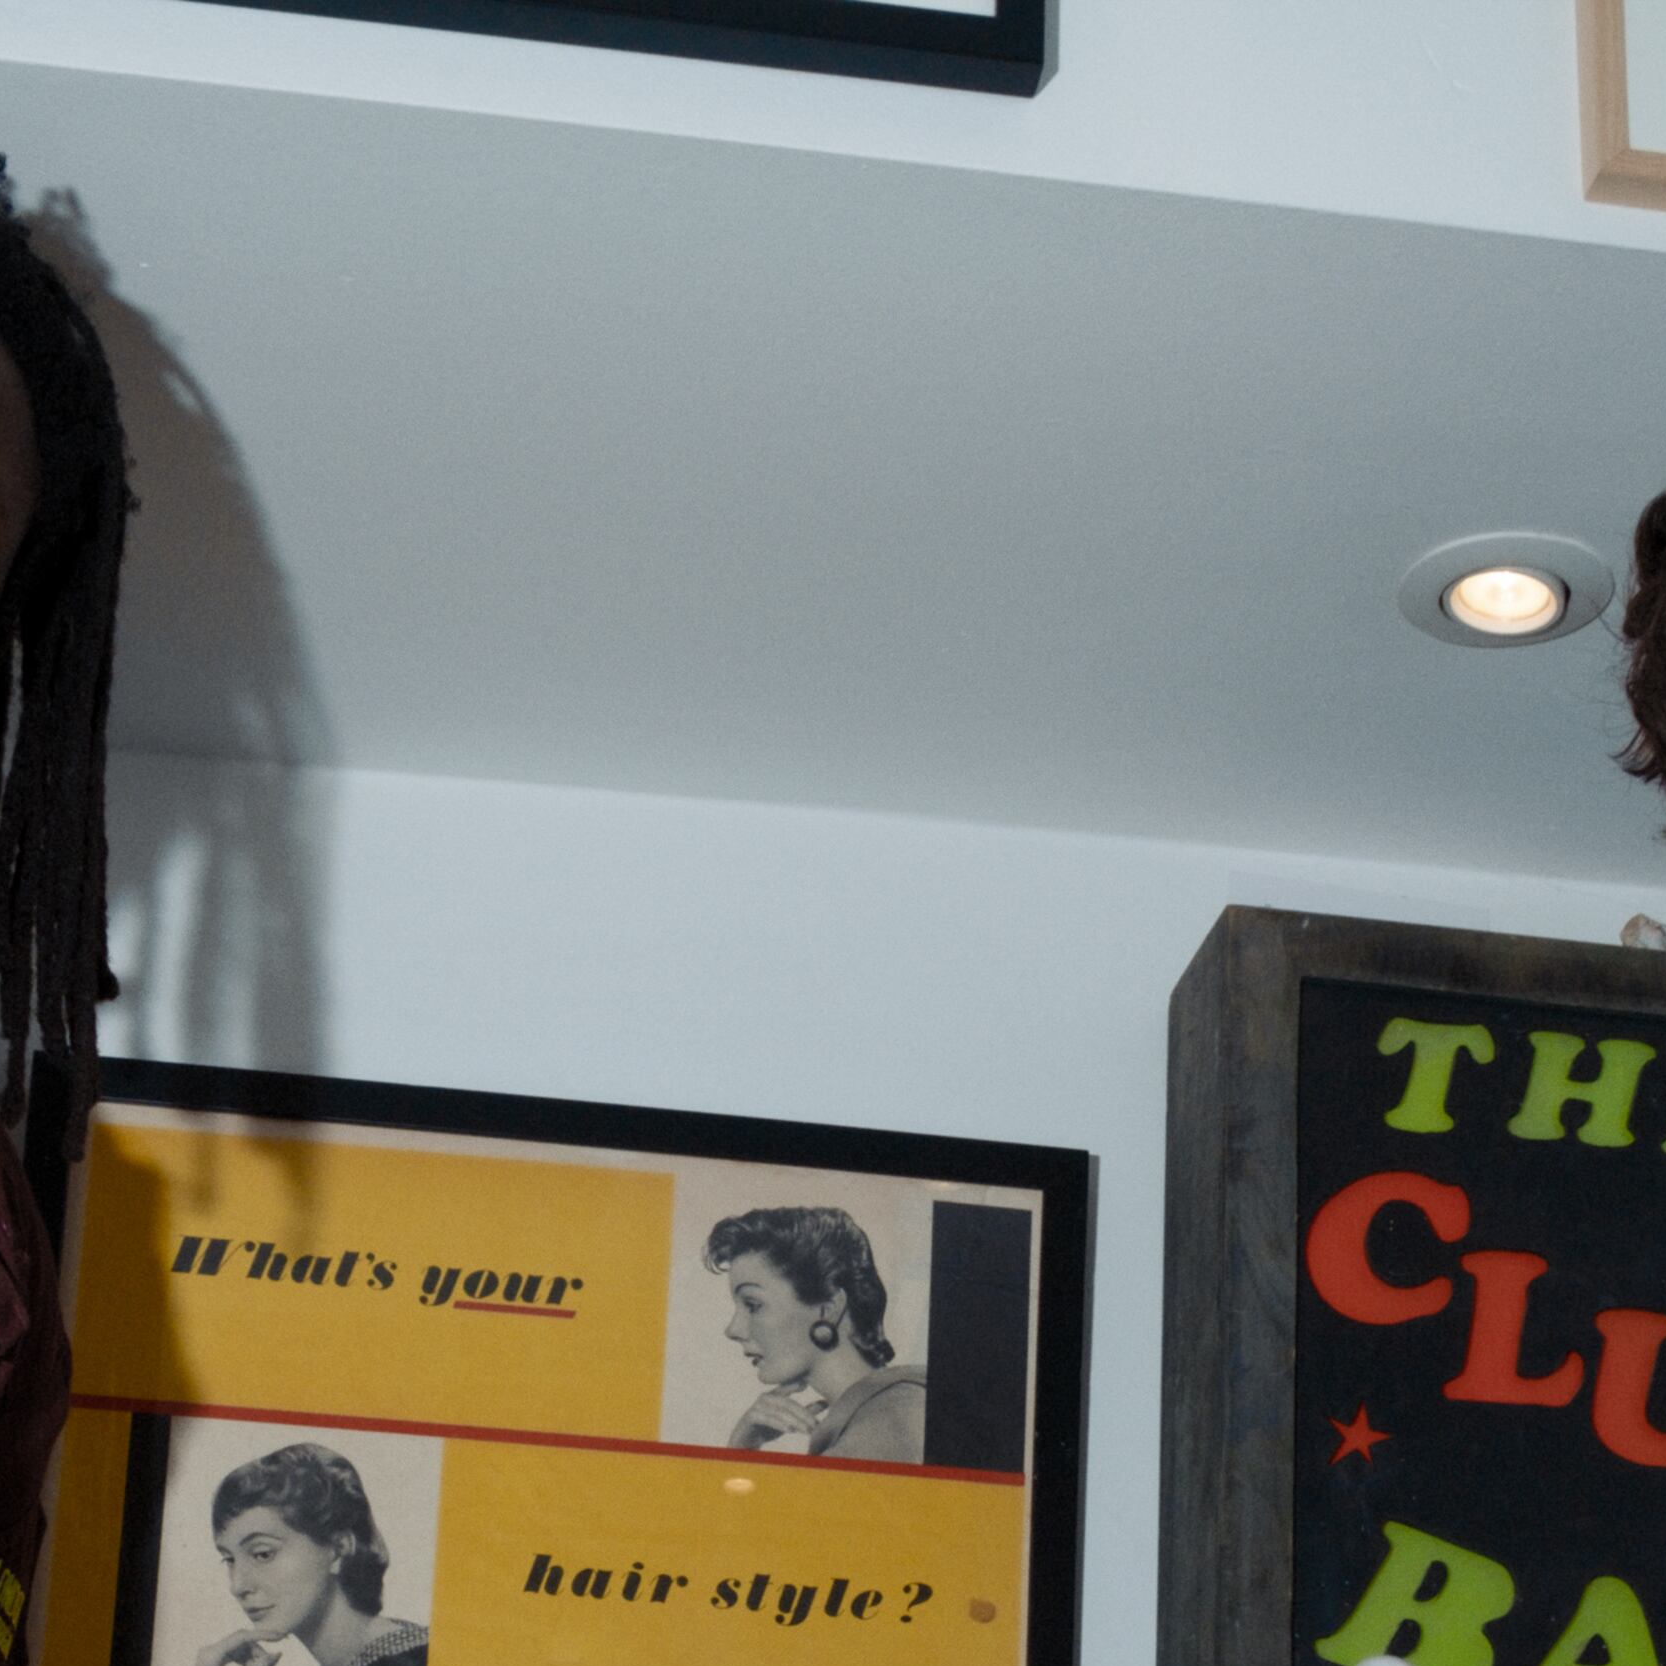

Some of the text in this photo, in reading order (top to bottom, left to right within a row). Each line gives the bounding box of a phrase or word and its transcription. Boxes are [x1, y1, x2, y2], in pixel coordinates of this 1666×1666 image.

[171, 1234, 584, 1307] What's your
[522, 1552, 690, 1605] hair
